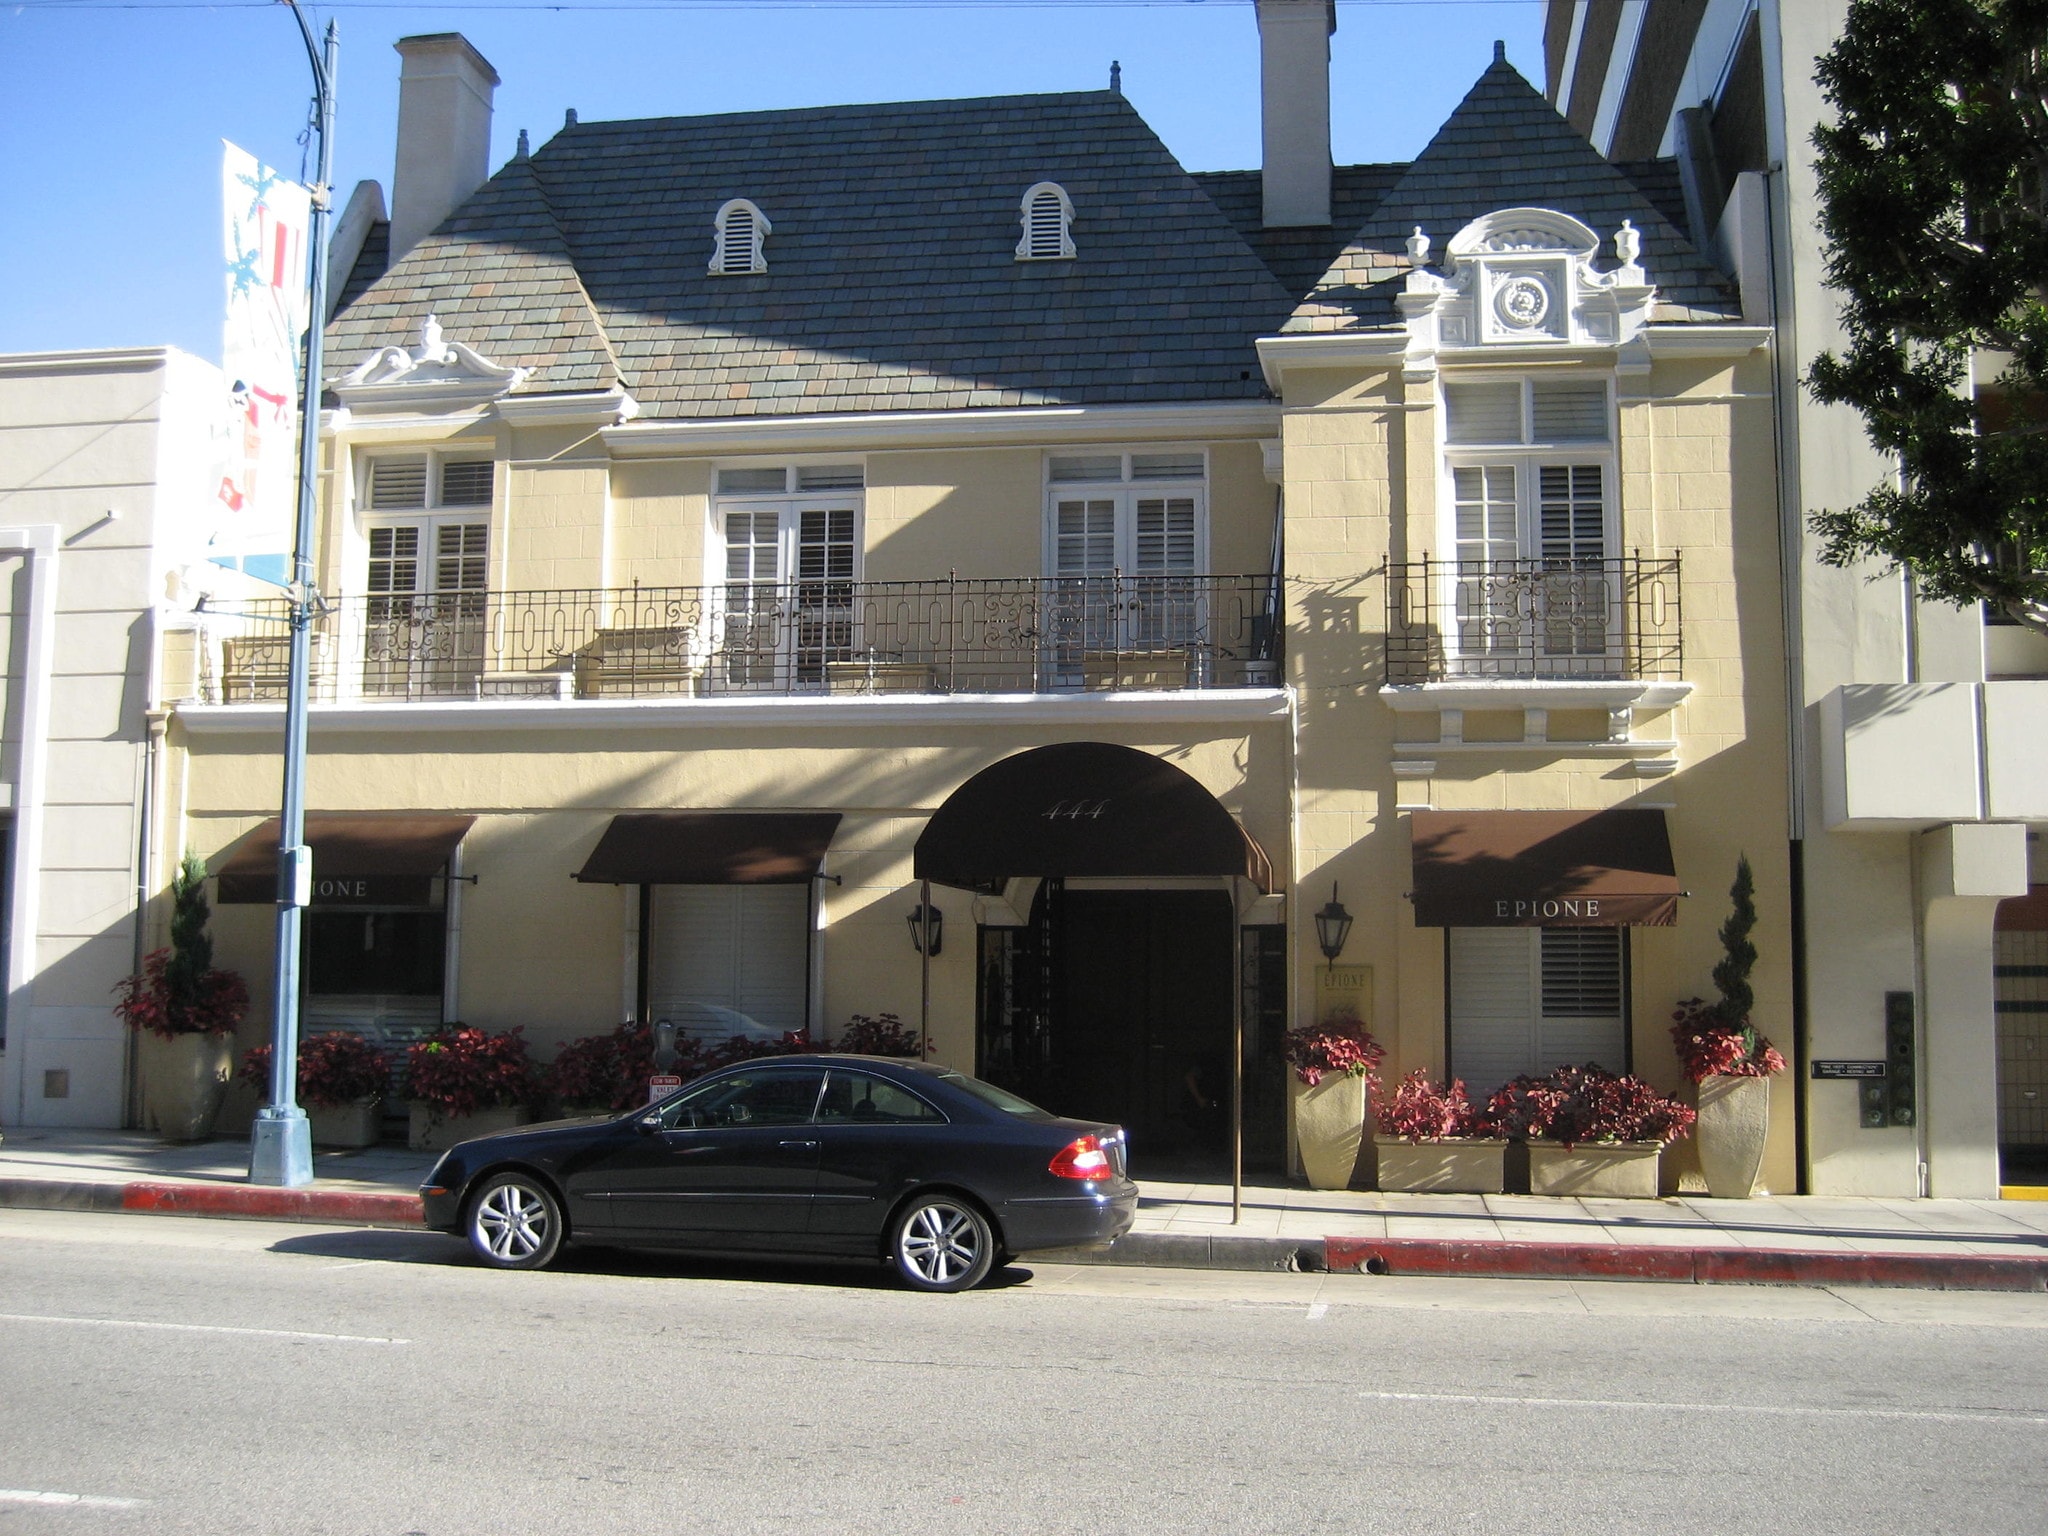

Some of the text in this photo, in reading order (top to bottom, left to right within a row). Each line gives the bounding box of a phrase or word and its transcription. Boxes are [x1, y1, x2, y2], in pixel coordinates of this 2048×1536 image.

[1041, 799, 1112, 820] 444
[312, 881, 367, 897] IONE
[1495, 900, 1600, 918] EPIONE
[1324, 974, 1366, 987] EPIONE
